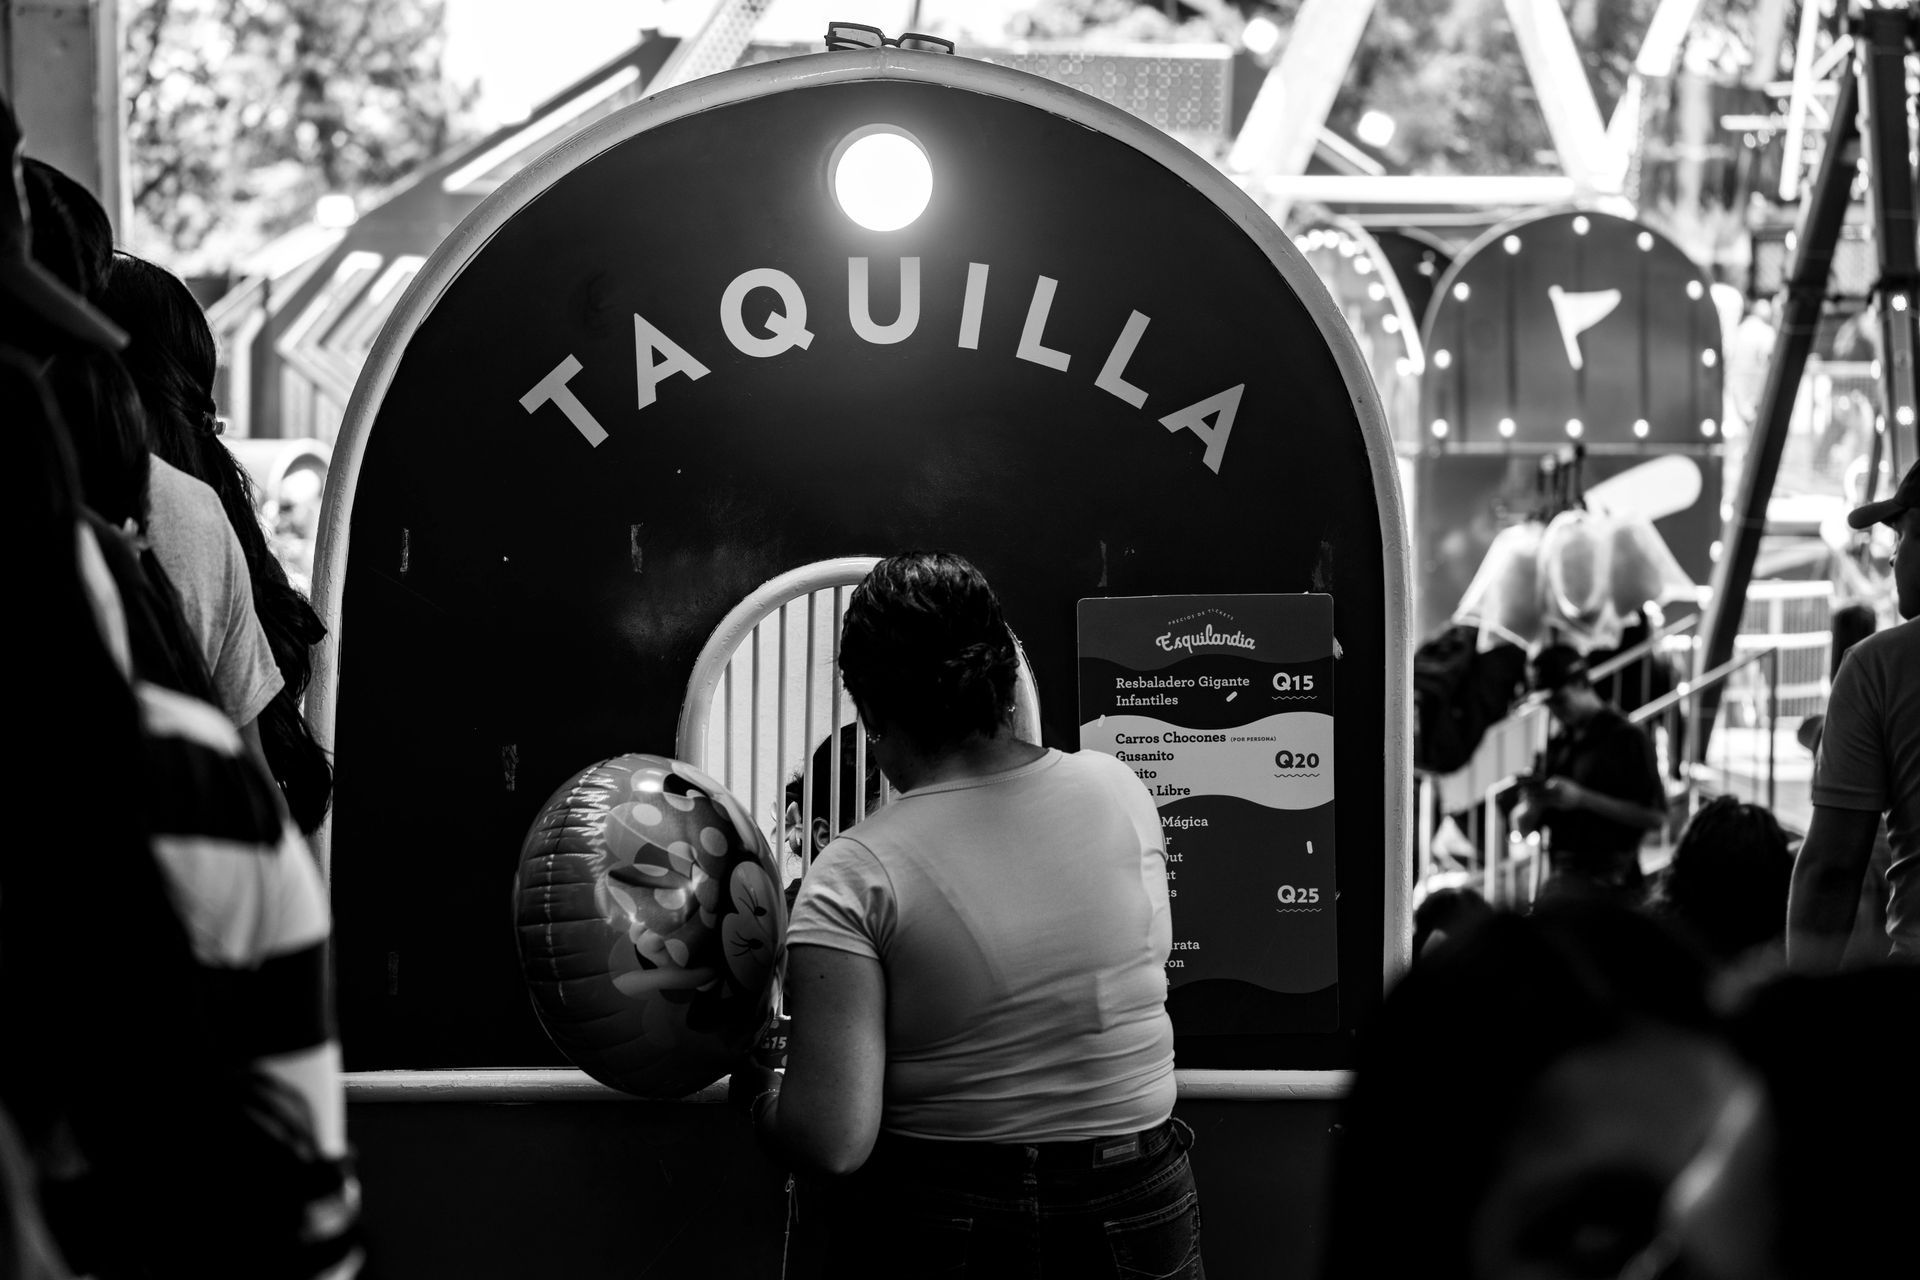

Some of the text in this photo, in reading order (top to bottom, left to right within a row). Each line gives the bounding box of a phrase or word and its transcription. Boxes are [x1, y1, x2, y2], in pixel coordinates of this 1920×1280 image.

[518, 256, 1245, 475] TAQUILLA
[1155, 624, 1256, 654] Esquilandia
[1115, 675, 1250, 690] Resbaladero Gigante
[1272, 672, 1314, 691] Q15
[1115, 695, 1179, 706] Infantiles
[1115, 733, 1160, 744] Carros
[1162, 731, 1227, 744] Chocones
[1115, 751, 1175, 762] Gusanito
[1275, 750, 1320, 769] Q20
[1156, 784, 1191, 796] Libre
[1161, 816, 1209, 830] Mágica
[1277, 885, 1320, 904] Q25
